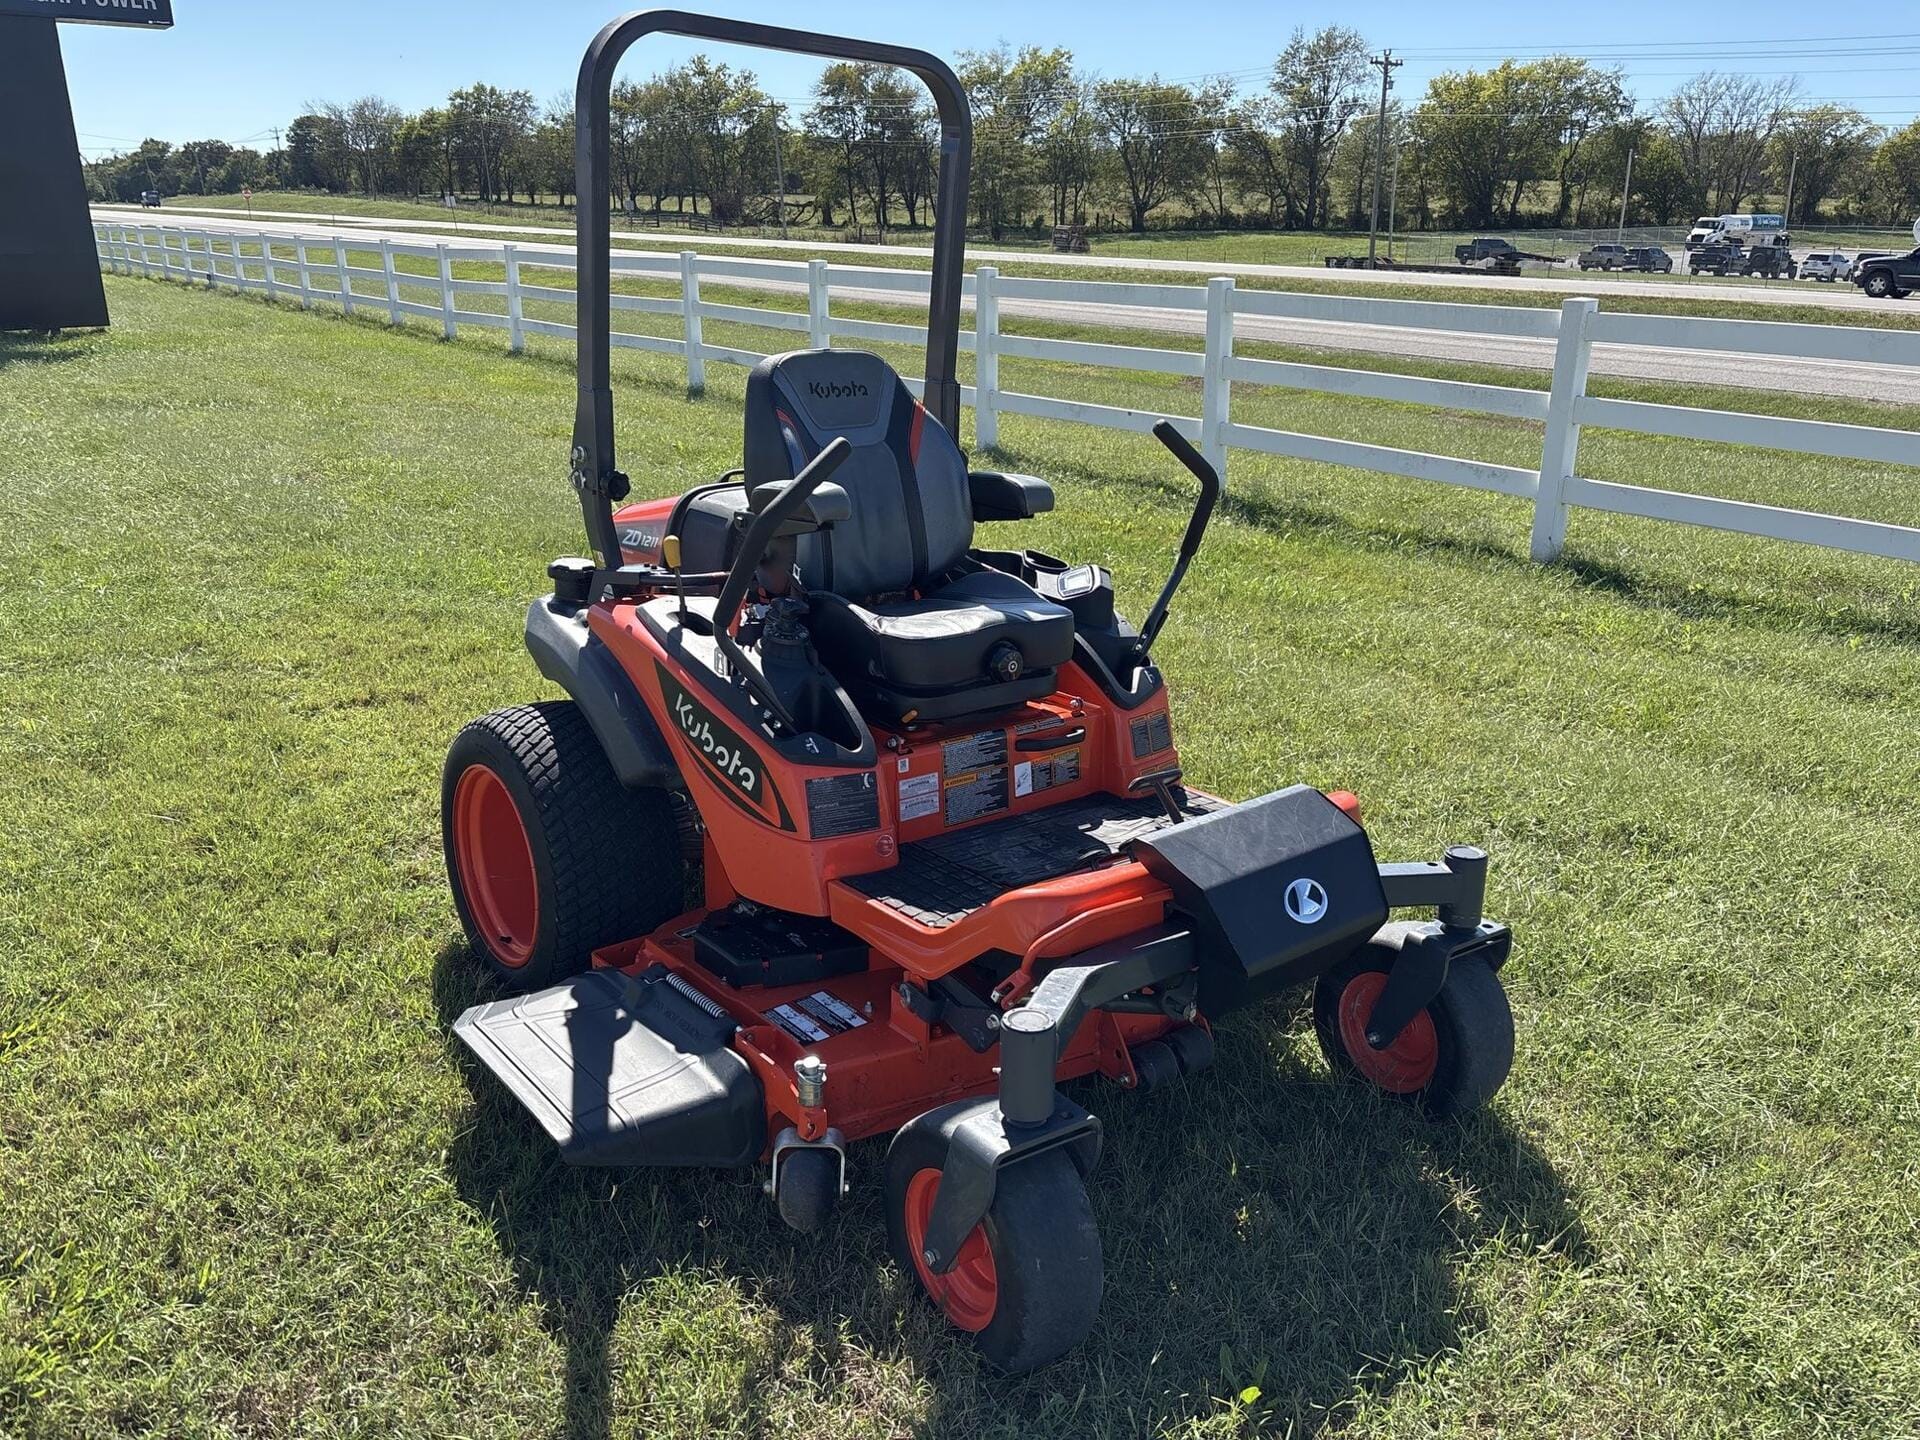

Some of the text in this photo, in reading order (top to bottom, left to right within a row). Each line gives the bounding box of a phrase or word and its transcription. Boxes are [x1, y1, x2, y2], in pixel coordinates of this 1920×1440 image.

[808, 381, 868, 398] Kubota
[622, 529, 659, 548] ZD1211
[675, 693, 756, 791] Kubota
